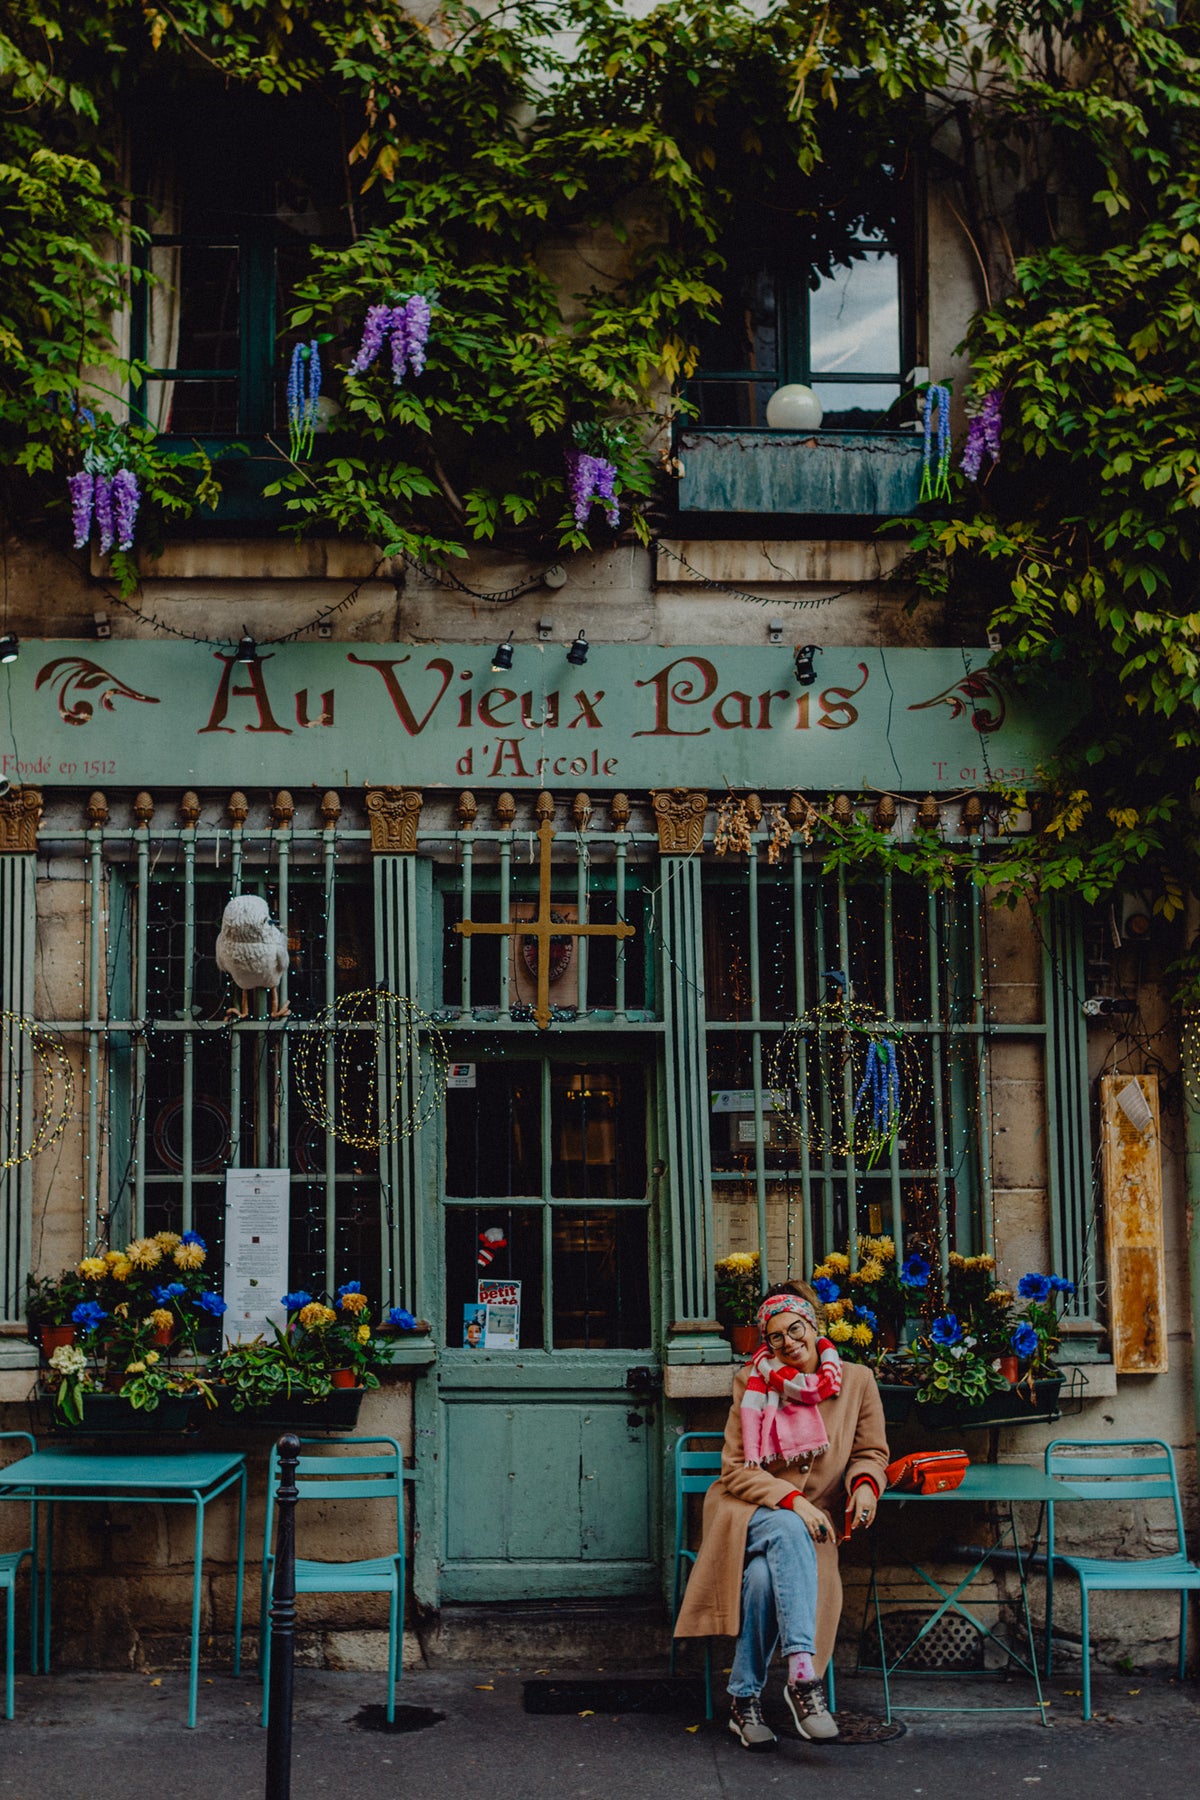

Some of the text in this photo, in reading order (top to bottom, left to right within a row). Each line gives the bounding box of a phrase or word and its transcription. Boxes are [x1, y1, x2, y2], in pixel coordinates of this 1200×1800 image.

[197, 652, 869, 738] Au Vieux Paris
[2, 754, 117, 778] Fondé en 1512
[456, 737, 618, 778] d'Arcole
[480, 1285, 517, 1302] petit
